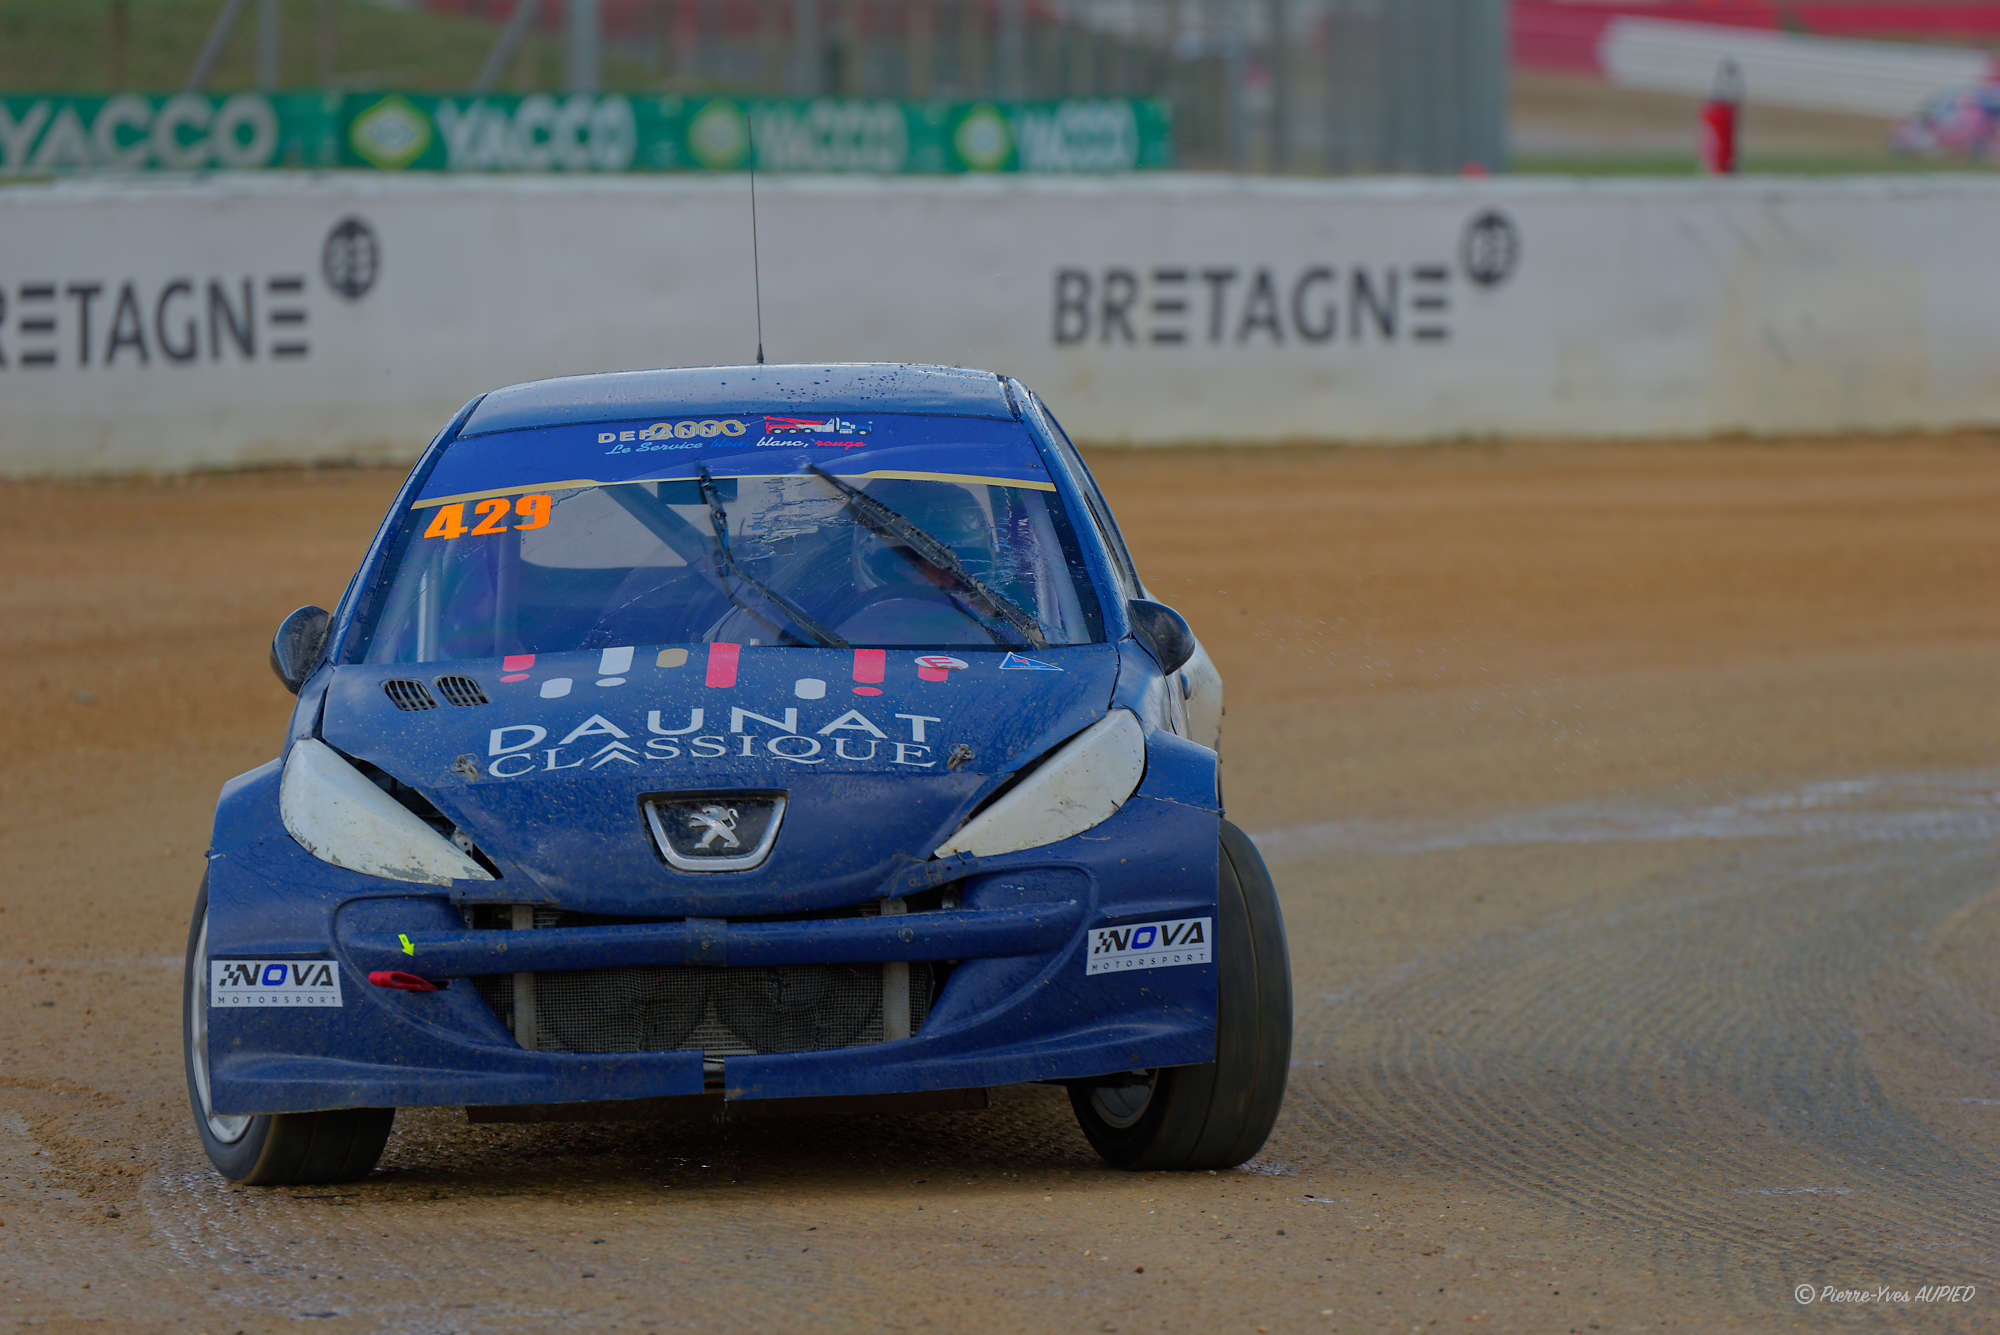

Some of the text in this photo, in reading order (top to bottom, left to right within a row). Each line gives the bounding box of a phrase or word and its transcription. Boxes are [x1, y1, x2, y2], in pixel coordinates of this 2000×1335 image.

[0, 92, 279, 175] YACCO
[0, 275, 310, 368] ETAGNE
[1053, 267, 1451, 345] BRETAGNE
[604, 443, 631, 455] Le
[636, 441, 703, 452] Service
[757, 437, 809, 447] blanc,
[814, 440, 867, 450] rouge
[424, 494, 552, 540] 429
[488, 706, 941, 757] DAUNAT
[488, 736, 937, 778] CLASSIQUE
[1094, 921, 1204, 953] NOVA
[219, 963, 334, 987] NOVA
[1092, 953, 1206, 971] MOTORSPORT
[217, 996, 337, 1004] MOTORSPORT
